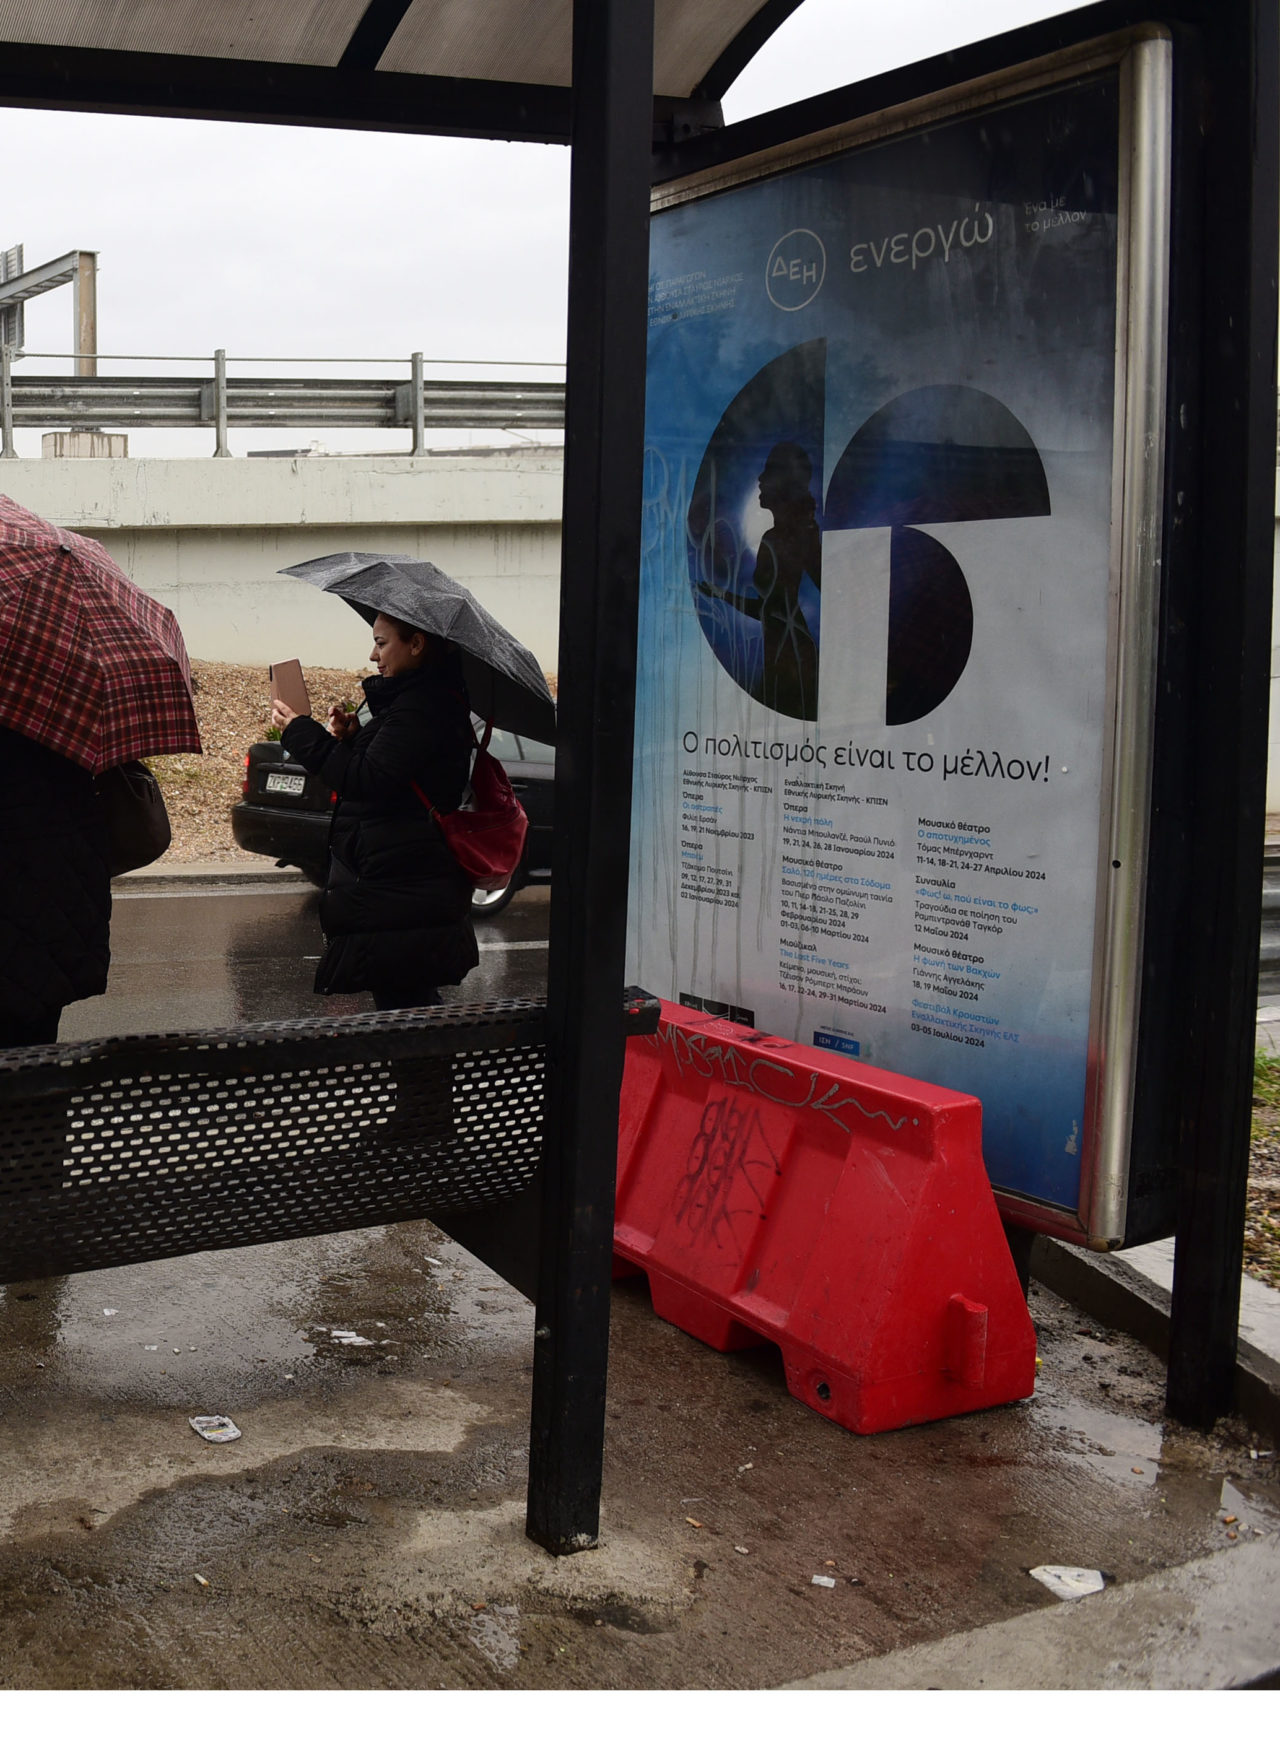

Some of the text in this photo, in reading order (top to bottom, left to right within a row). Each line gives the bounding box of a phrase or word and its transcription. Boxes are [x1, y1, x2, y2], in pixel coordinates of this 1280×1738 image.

[850, 202, 993, 272] ενεργώ
[772, 256, 816, 284] ΔΕΗ
[683, 732, 1050, 782] Ο πολιτισμός είναι το μέλλον!
[683, 791, 703, 800] Όπερα
[825, 783, 845, 792] Σκηνή
[784, 803, 808, 813] Όπερα
[918, 817, 991, 834] Μουσικό θέατρο
[681, 841, 703, 850] Όπερα
[926, 832, 991, 847] αποτυχημένος
[834, 845, 875, 858] Ιανουαρίου
[877, 851, 894, 859] 2024
[917, 843, 994, 860] Τόμας Μπέρνχαρντ
[783, 856, 843, 872] Μουσικό θέατρο
[917, 856, 1046, 880] 11-14, 18-21, 24-27 Απριλίου 2024
[818, 885, 834, 894] στην
[915, 875, 956, 889] Συναυλία
[955, 894, 972, 904] πού
[974, 897, 996, 908] είναι
[998, 901, 1009, 910] το
[915, 900, 1018, 924] Τραγούδια σε ποίηση του
[829, 918, 845, 928] 2024
[915, 912, 1003, 935] Ραμπιντρανάθ Ταγκόρ
[821, 927, 851, 940] Μαρτίου
[853, 933, 869, 943] 2024
[914, 924, 922, 933] 12
[950, 930, 969, 941] 2024
[780, 938, 817, 952] Μιούζικαλ
[914, 942, 984, 964] Μουσικό θέατρο
[913, 967, 984, 991] Γιάννης Αγγελάκης
[948, 963, 964, 972] των
[966, 965, 1000, 979] Βακχών
[913, 980, 922, 989] 18,
[924, 982, 931, 990] 19
[959, 990, 978, 1001] 2024
[819, 991, 837, 1001] 29-31
[838, 996, 868, 1009] Μαρτίου
[869, 1003, 886, 1013] 2024
[912, 999, 999, 1025] Φεστιβάλ Κρουστών
[912, 1010, 967, 1032] Εναλλακτικής
[969, 1023, 1001, 1039] Σκηνής
[911, 1023, 985, 1047] 03-05 Ιουλίου 2024
